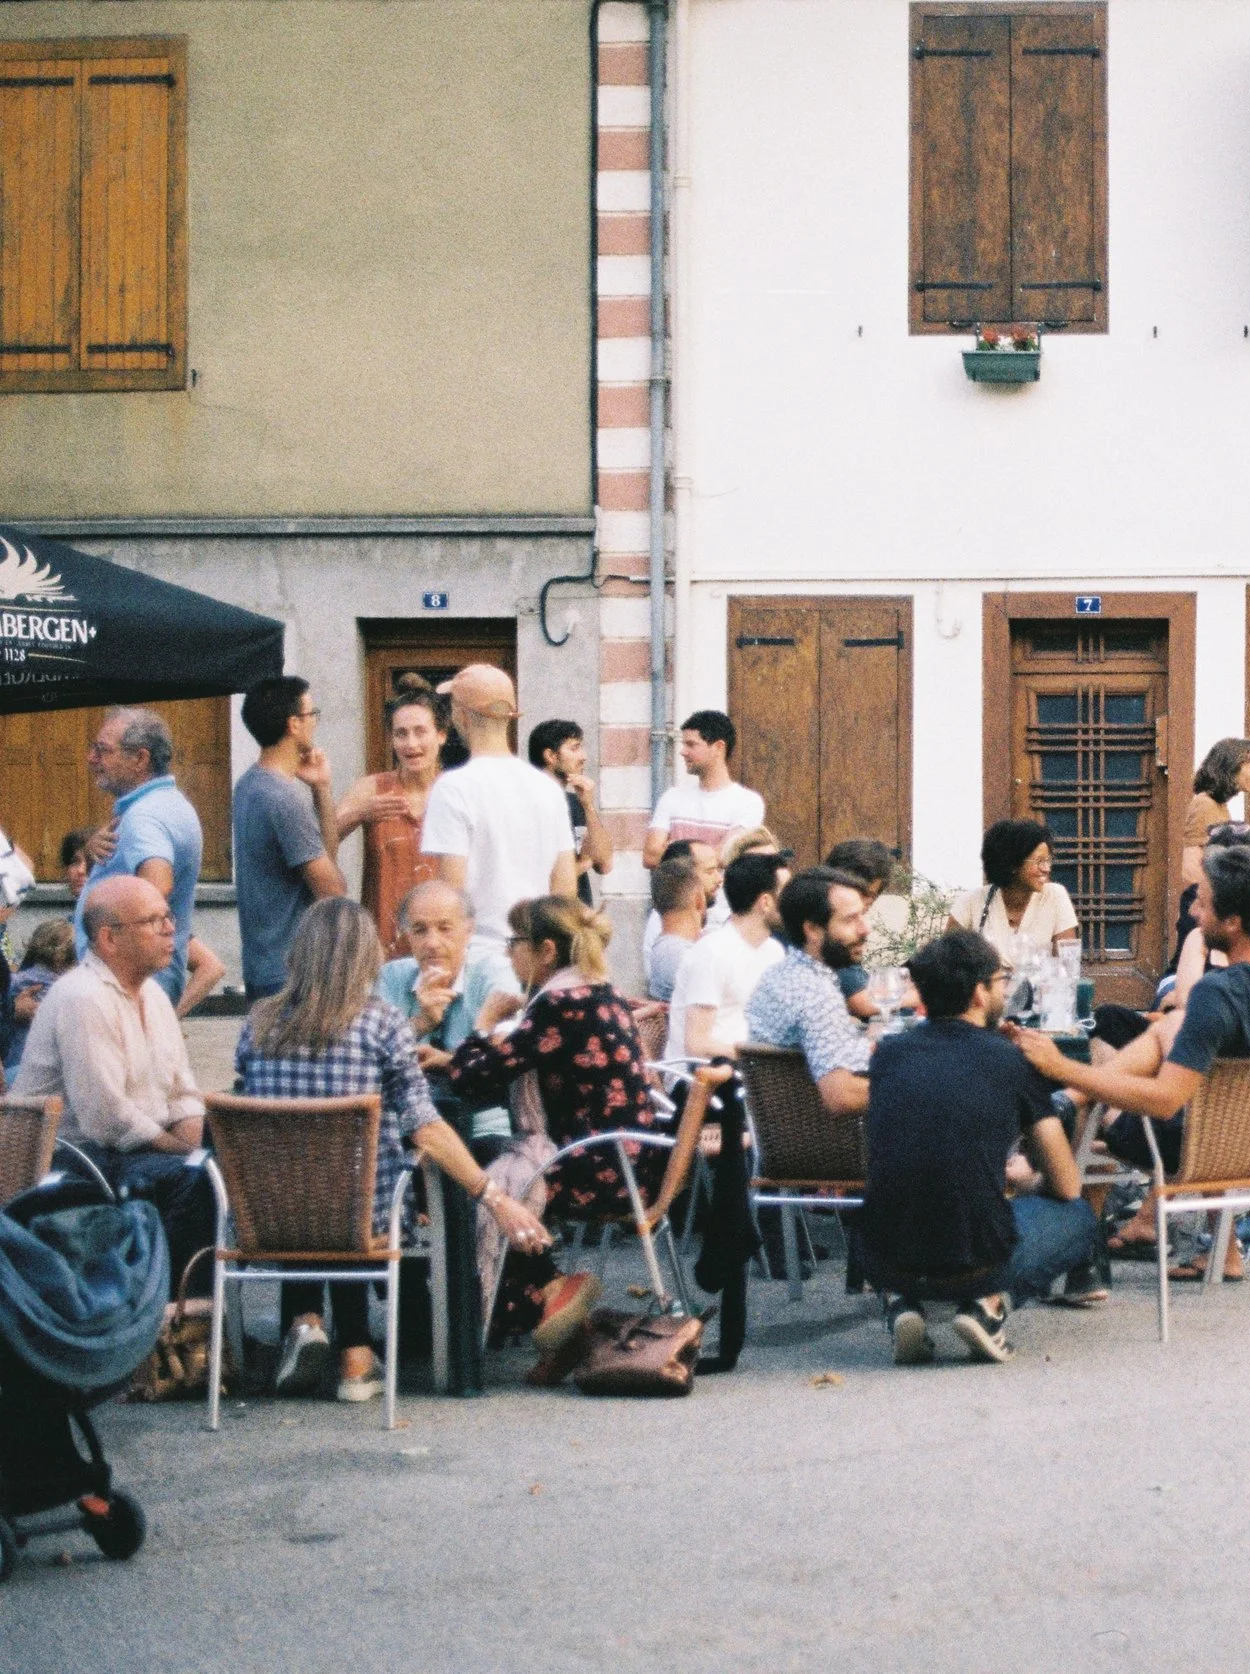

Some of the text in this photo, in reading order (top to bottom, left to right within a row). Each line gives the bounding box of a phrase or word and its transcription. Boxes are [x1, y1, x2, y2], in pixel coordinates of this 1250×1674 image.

[431, 594, 441, 607] 8
[1083, 599, 1093, 611] 7
[0, 613, 88, 644] BERGEN
[4, 648, 26, 662] 1128
